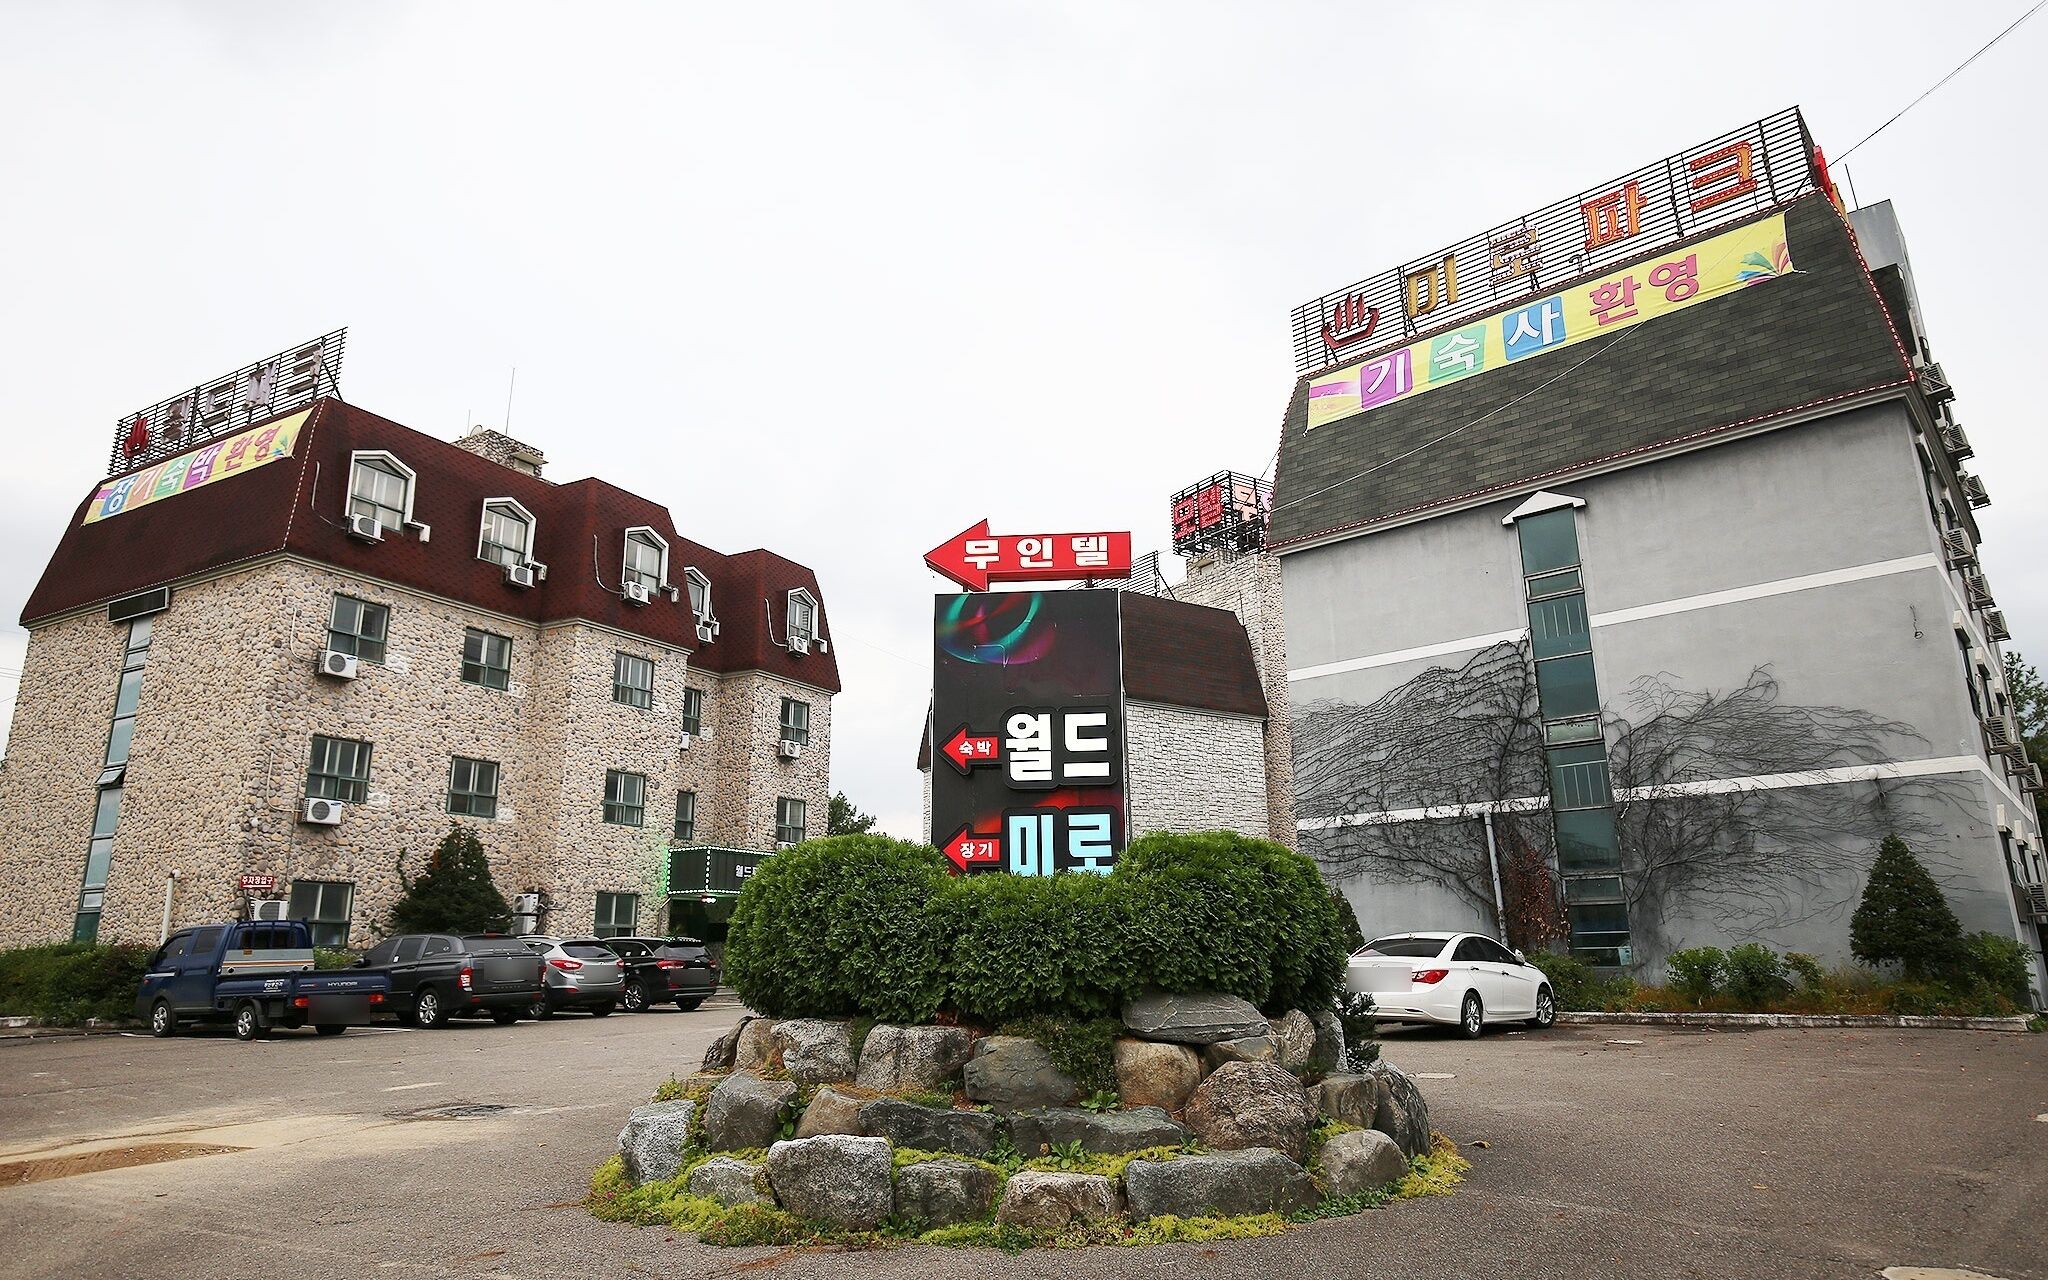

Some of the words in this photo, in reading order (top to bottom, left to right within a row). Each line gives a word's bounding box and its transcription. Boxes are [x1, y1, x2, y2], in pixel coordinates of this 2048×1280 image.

[1406, 141, 1757, 318] 미로파크
[1366, 301, 1560, 395] 기숙사
[1589, 253, 1701, 326] 환영
[108, 441, 222, 512] 장기숙박
[224, 425, 282, 472] 환영
[1173, 483, 1223, 541] 모텔
[963, 535, 1109, 570] 무인텔
[958, 740, 992, 756] 숙박
[1005, 712, 1110, 782] 월드
[959, 841, 994, 859] 장기
[1008, 813, 1114, 878] 미로
